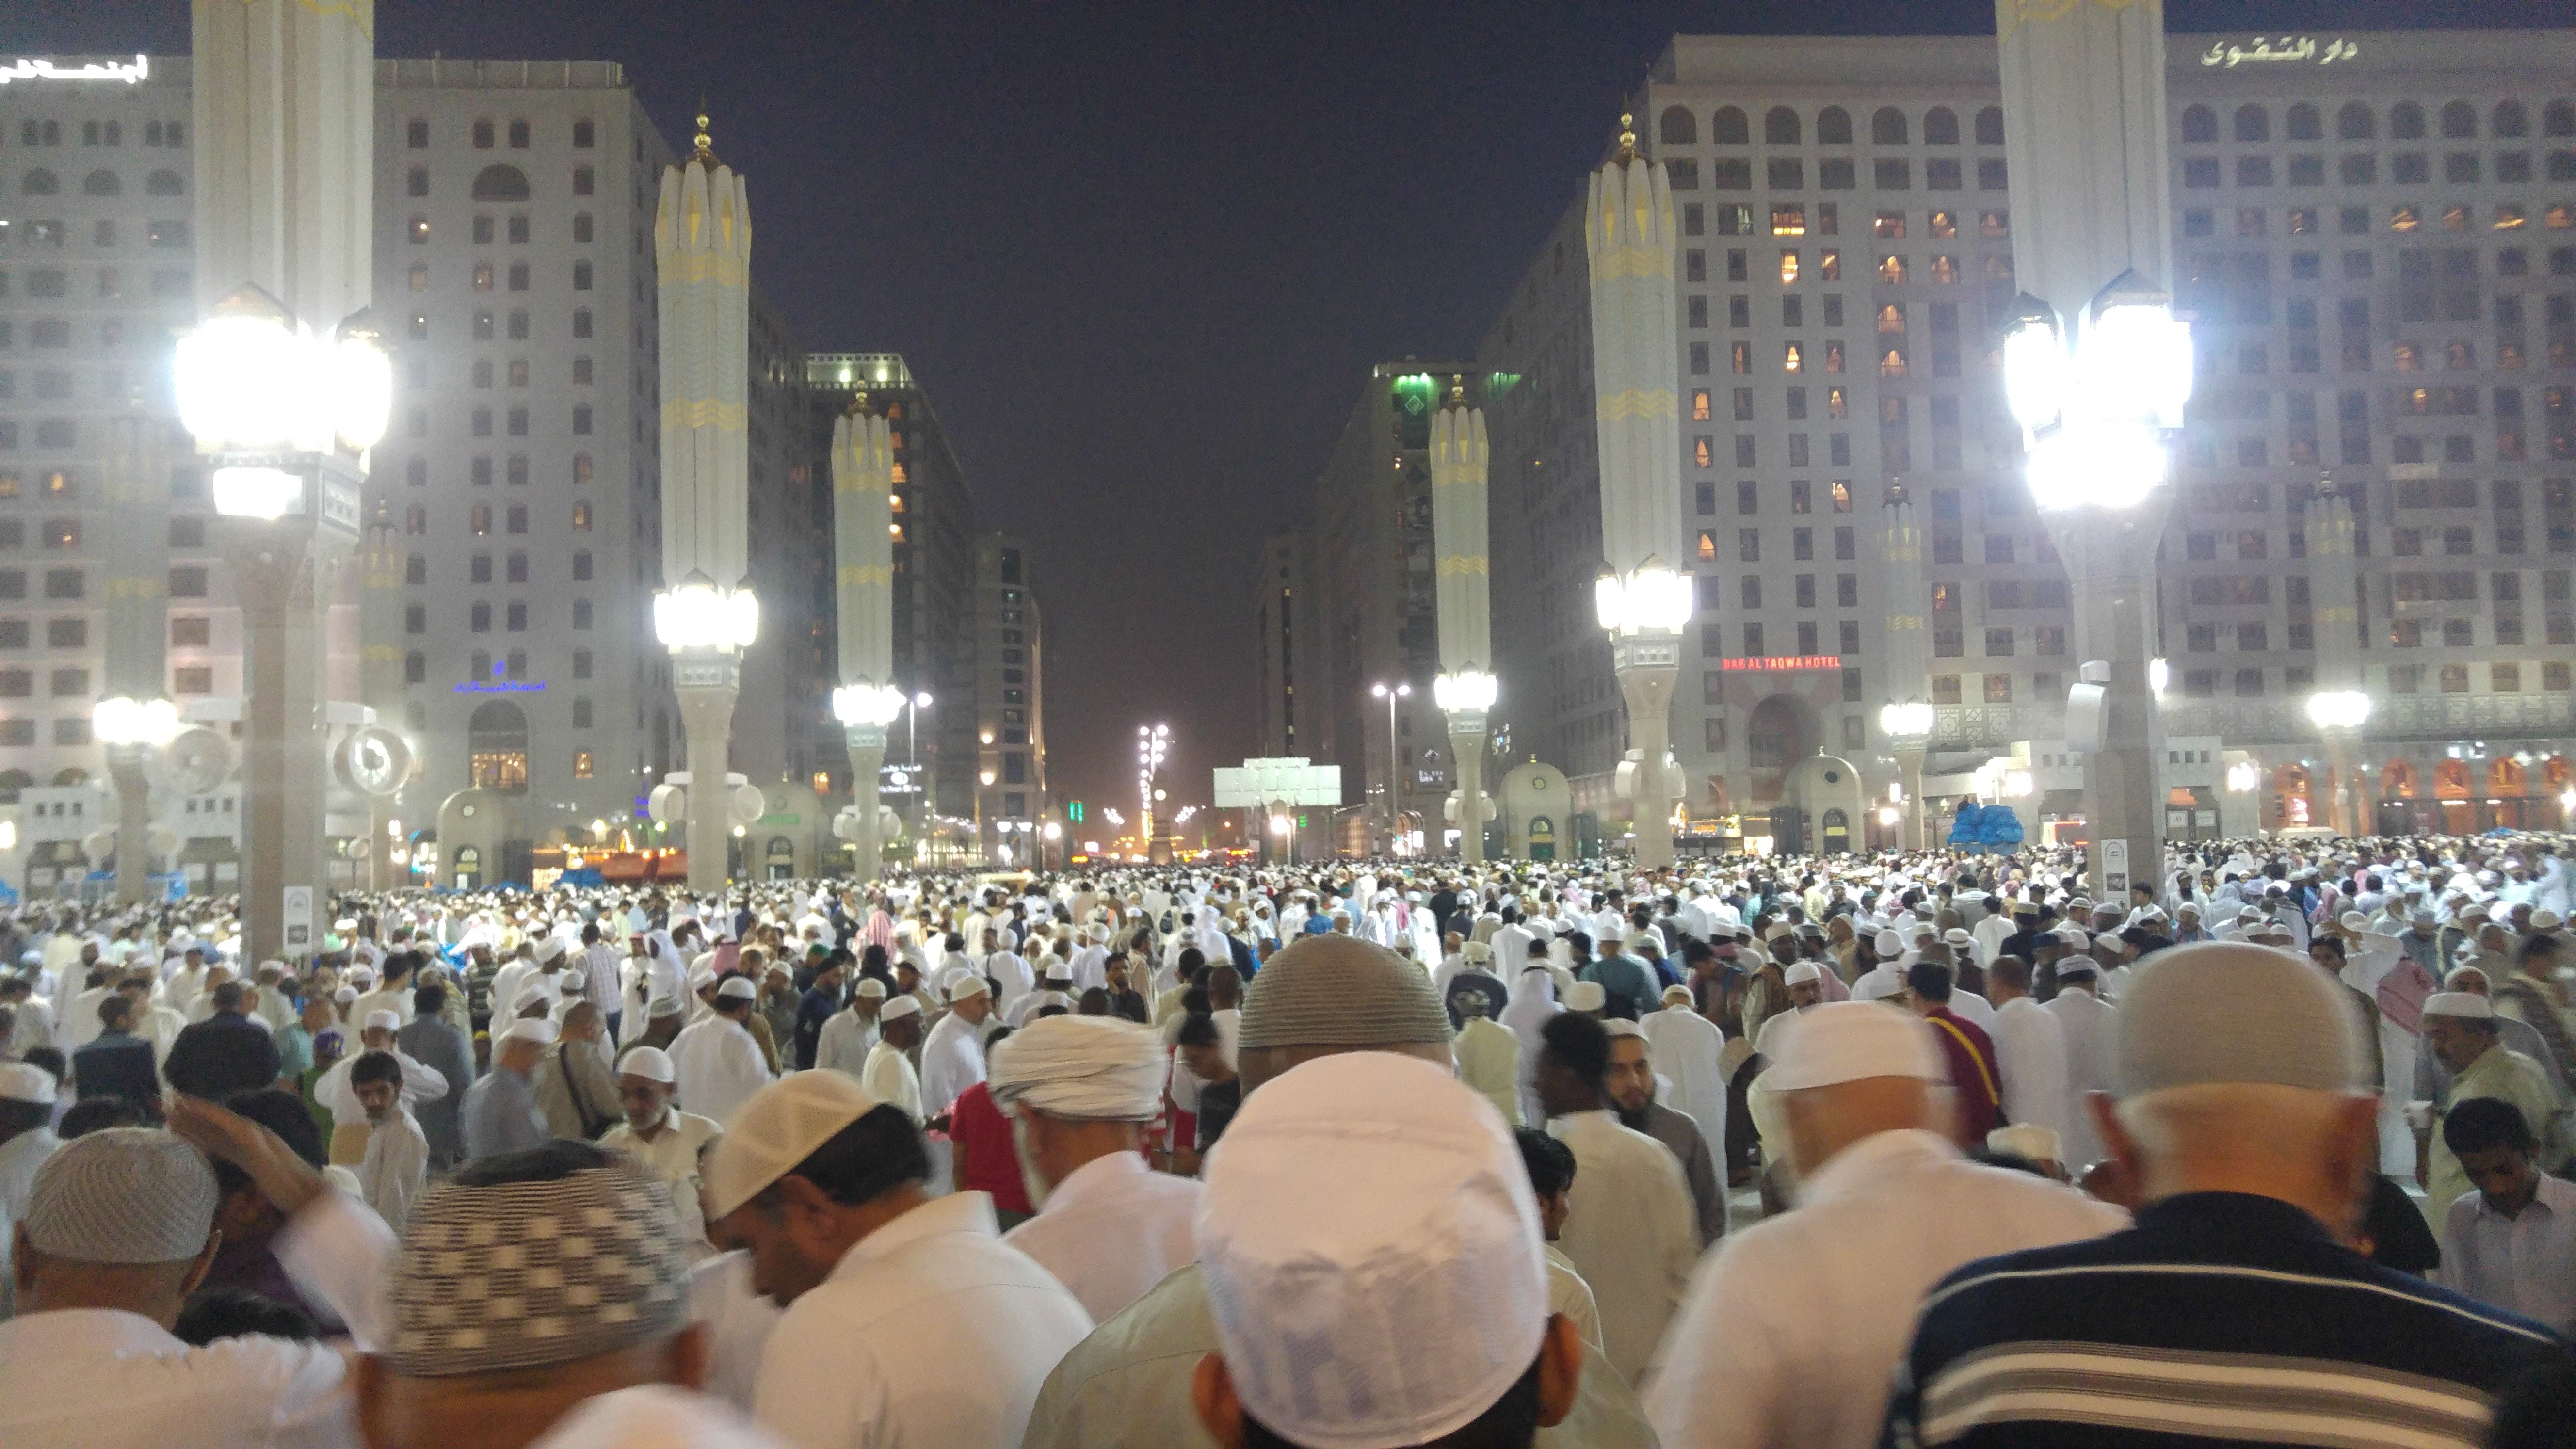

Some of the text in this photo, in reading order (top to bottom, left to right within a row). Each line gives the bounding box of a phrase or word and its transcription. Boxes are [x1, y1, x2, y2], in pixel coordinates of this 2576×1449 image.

[2201, 36, 2358, 68] دار التقوى
[1723, 656, 1840, 669] DAR AL TAQWA HOTEL
